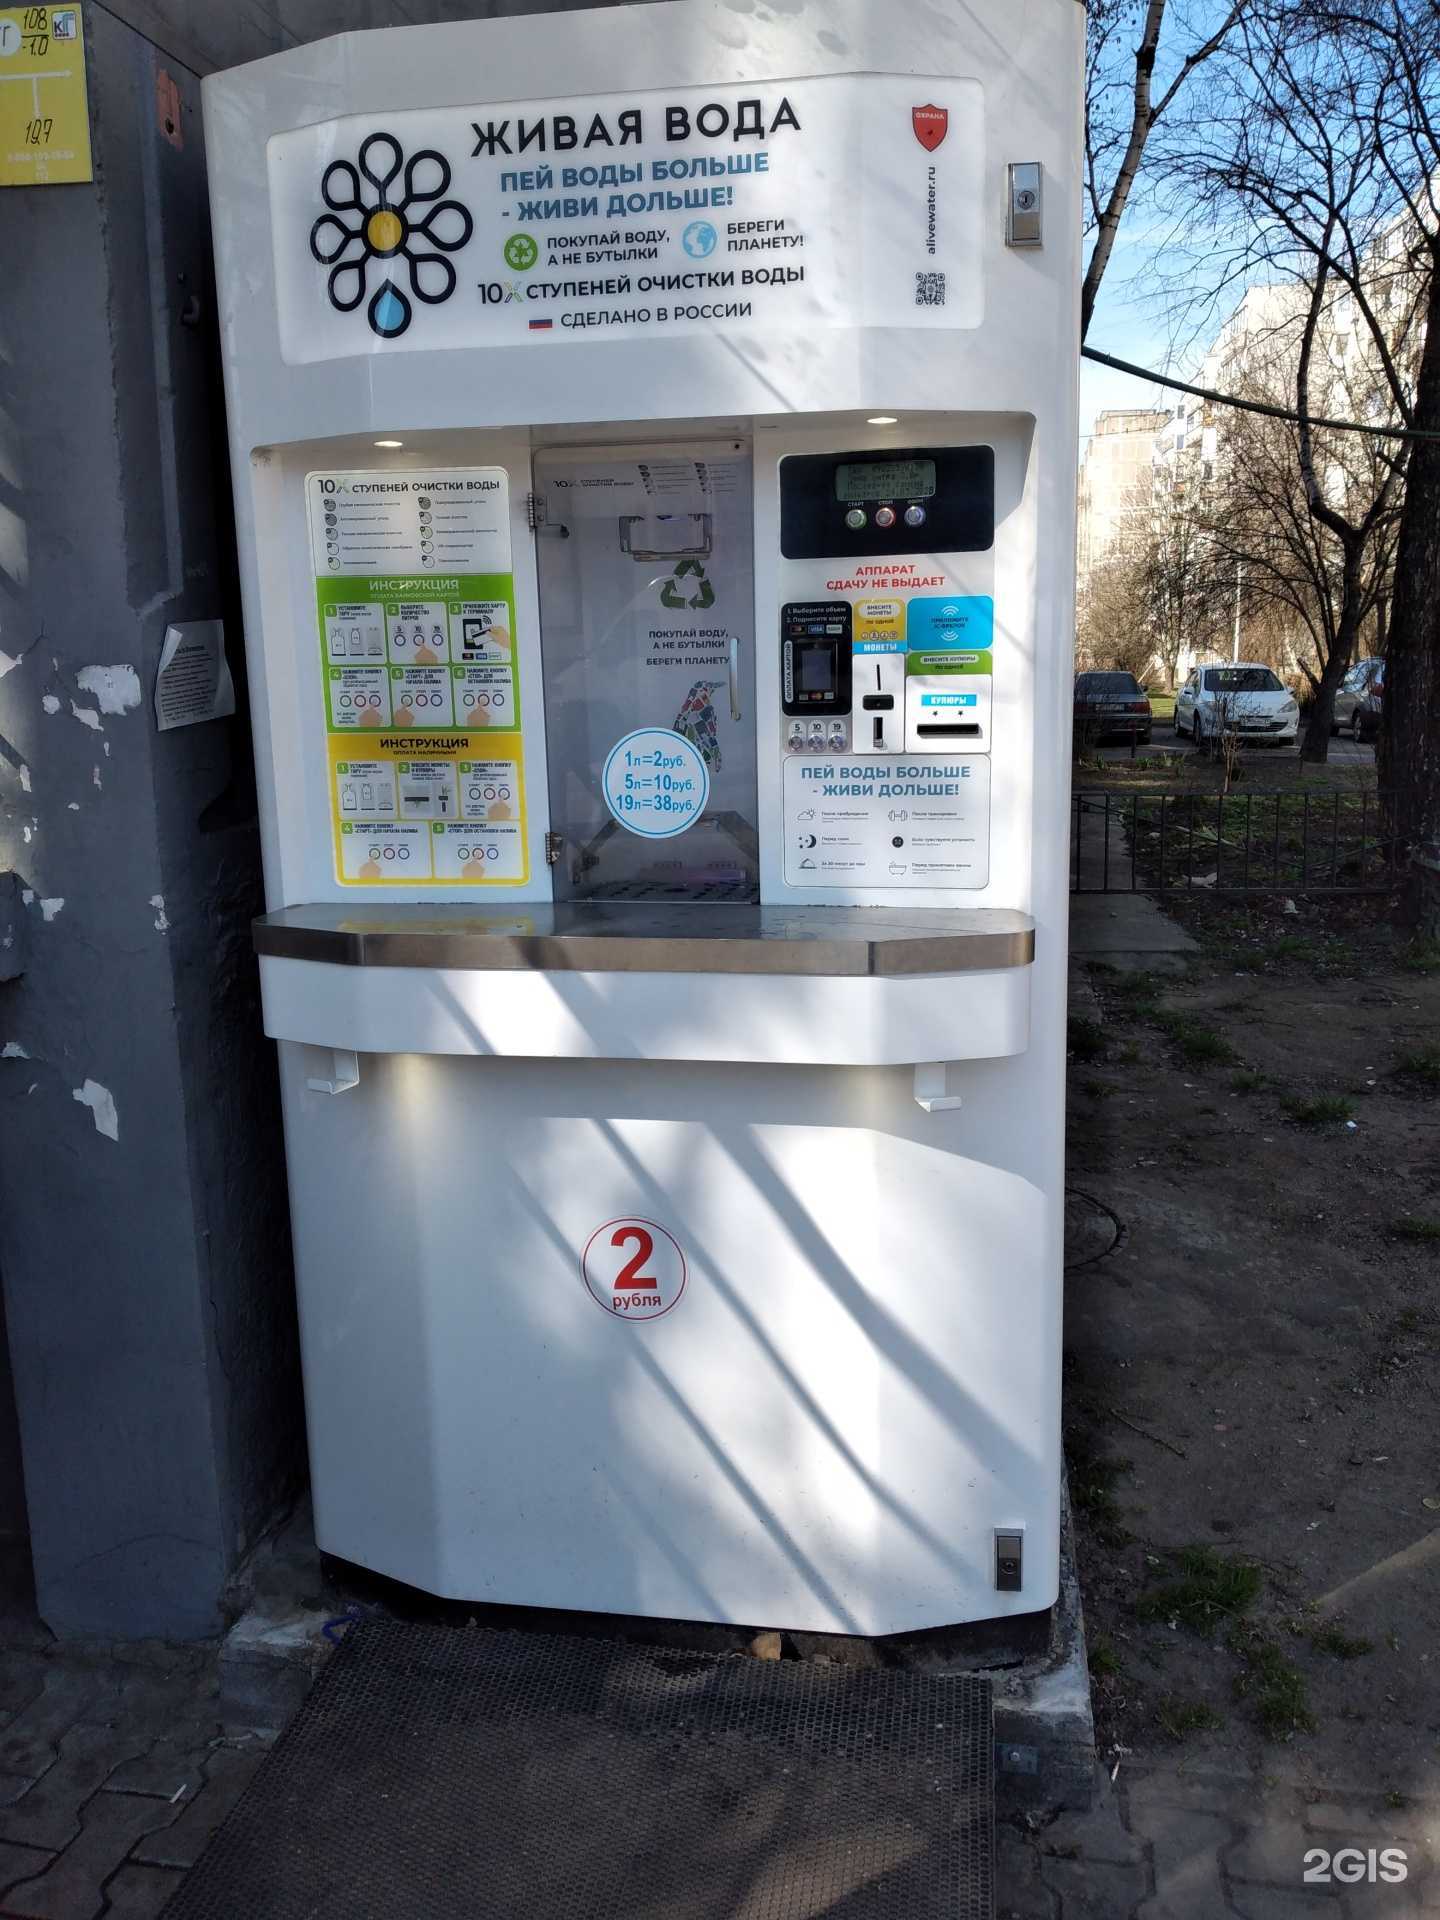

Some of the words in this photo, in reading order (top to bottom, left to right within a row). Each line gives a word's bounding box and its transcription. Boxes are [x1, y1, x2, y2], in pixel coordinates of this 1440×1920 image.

[24, 8, 48, 31] 108
[915, 112, 944, 120] ОХРАНА
[471, 109, 641, 157] ЖИВАЯ
[665, 97, 801, 142] ВОДА
[501, 165, 553, 192] ПЕЙ
[562, 161, 643, 189] ВОДЫ
[652, 152, 769, 181] БОЛЬШЕ
[518, 196, 598, 221] ЖИВИ
[606, 186, 733, 219] ДОЛЬШЕ!
[926, 166, 936, 254] alivewater.ru
[727, 219, 785, 235] БЕРЕГИ
[548, 230, 619, 249] ПОКУПАЙ
[625, 229, 670, 246] ВОДУ,
[727, 235, 804, 252] ПЛАНЕТУ!
[548, 254, 558, 266] А
[562, 252, 581, 265] НЕ
[586, 248, 658, 263] БУТЫЛКИ
[526, 275, 631, 300] СТУПЕНЕЙ
[637, 271, 734, 292] ОЧИСТКИ
[742, 266, 805, 285] ВОДЫ
[560, 309, 651, 328] СДЕЛАНО
[657, 308, 668, 322] В
[674, 302, 752, 321] РОССИИ
[352, 482, 408, 493] СТУПЕНЕЙ
[412, 482, 463, 491] ОЧИСТКИ
[467, 481, 500, 490] ВОДЫ
[856, 565, 916, 576] АППАРАТ
[369, 580, 459, 591] ИНСТРУКЦИЯ
[827, 579, 868, 590] СДАЧУ
[872, 579, 887, 588] НЕ
[891, 576, 945, 588] ВЫДАЕТ
[649, 628, 696, 639] ПОКУПАЙ
[699, 629, 729, 639] ВОДУ,
[653, 641, 660, 649] А
[663, 641, 675, 649] НЕ
[678, 640, 725, 648] БУТЫЛКИ
[863, 643, 897, 651] МОНЕТЫ
[646, 657, 682, 666] БЕРЕГИ
[685, 656, 729, 665] ПЛАНЕТУ
[931, 696, 967, 705] КУПЮРЫ
[380, 738, 469, 749] ИНСТРУКЦИЯ
[801, 764, 834, 779] ПЕЙ
[840, 767, 891, 780] ВОДЫ
[896, 766, 971, 778] БОЛЬШЕ
[822, 784, 873, 796] ЖИВИ
[878, 784, 959, 798] ДОЛЬШЕ!
[611, 1226, 658, 1290] 2
[612, 1293, 662, 1310] рубля
